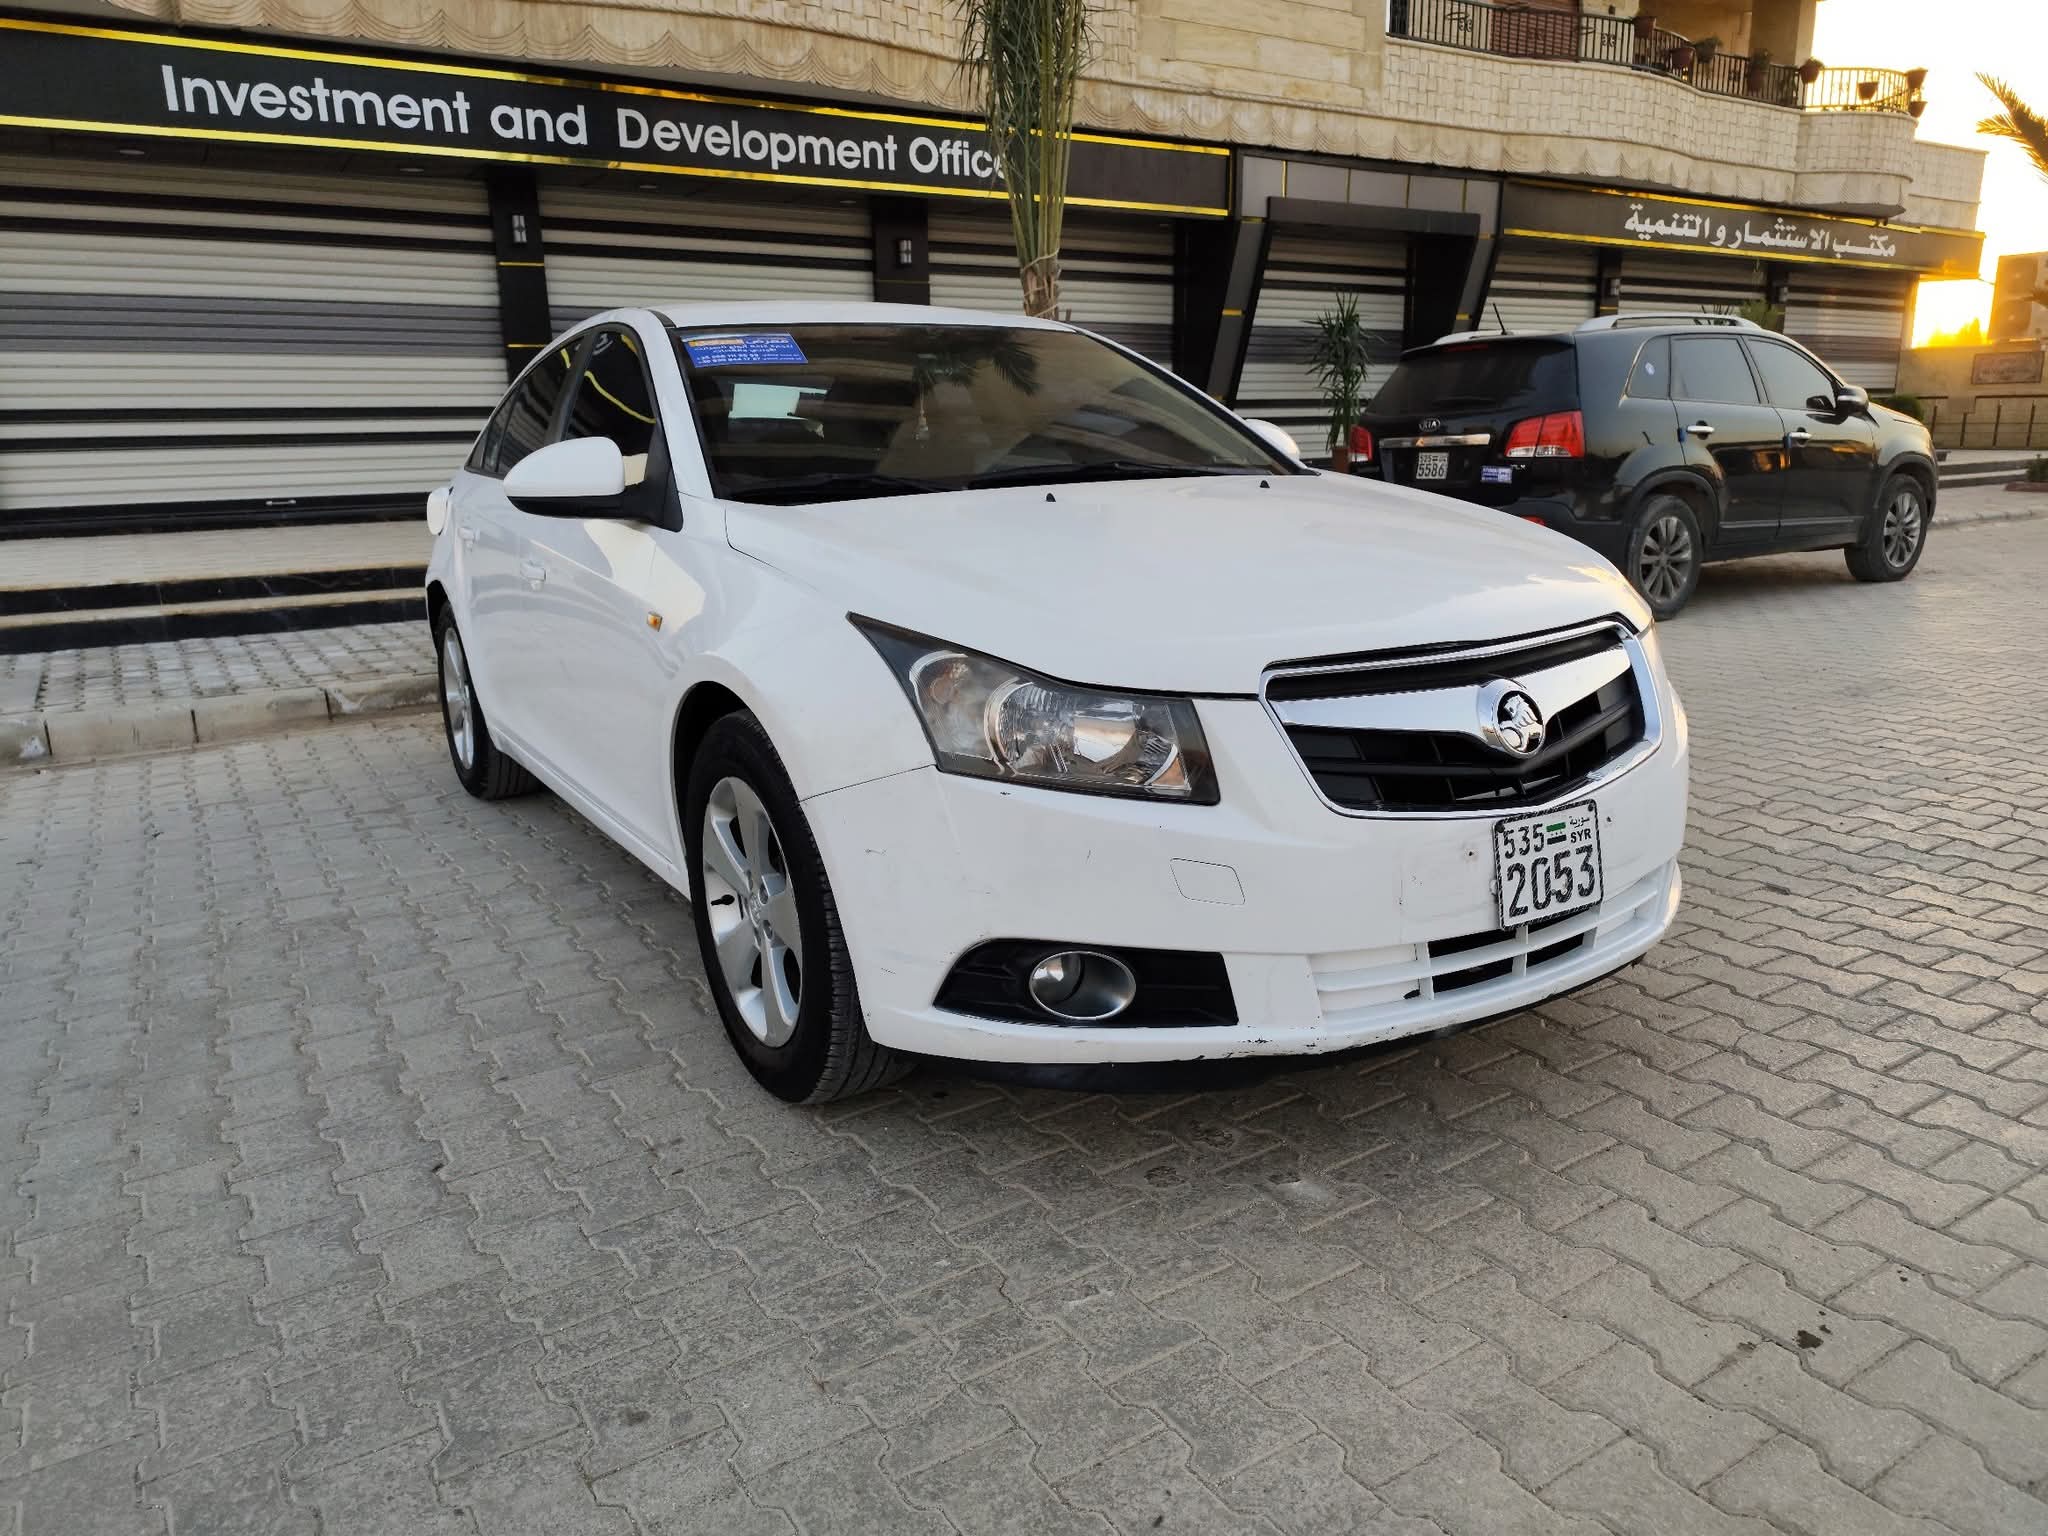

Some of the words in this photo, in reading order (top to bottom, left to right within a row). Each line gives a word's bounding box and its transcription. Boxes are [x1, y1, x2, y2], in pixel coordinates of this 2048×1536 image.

[161, 64, 471, 134] Investment
[490, 104, 588, 146] and
[616, 107, 898, 171] Development
[1727, 216, 1831, 250] الاستثمار
[1832, 233, 1897, 258] مكتب
[1418, 462, 1444, 477] 5586
[1503, 823, 1545, 859] 535
[1570, 828, 1592, 843] SYR
[1506, 844, 1596, 918] 2053
